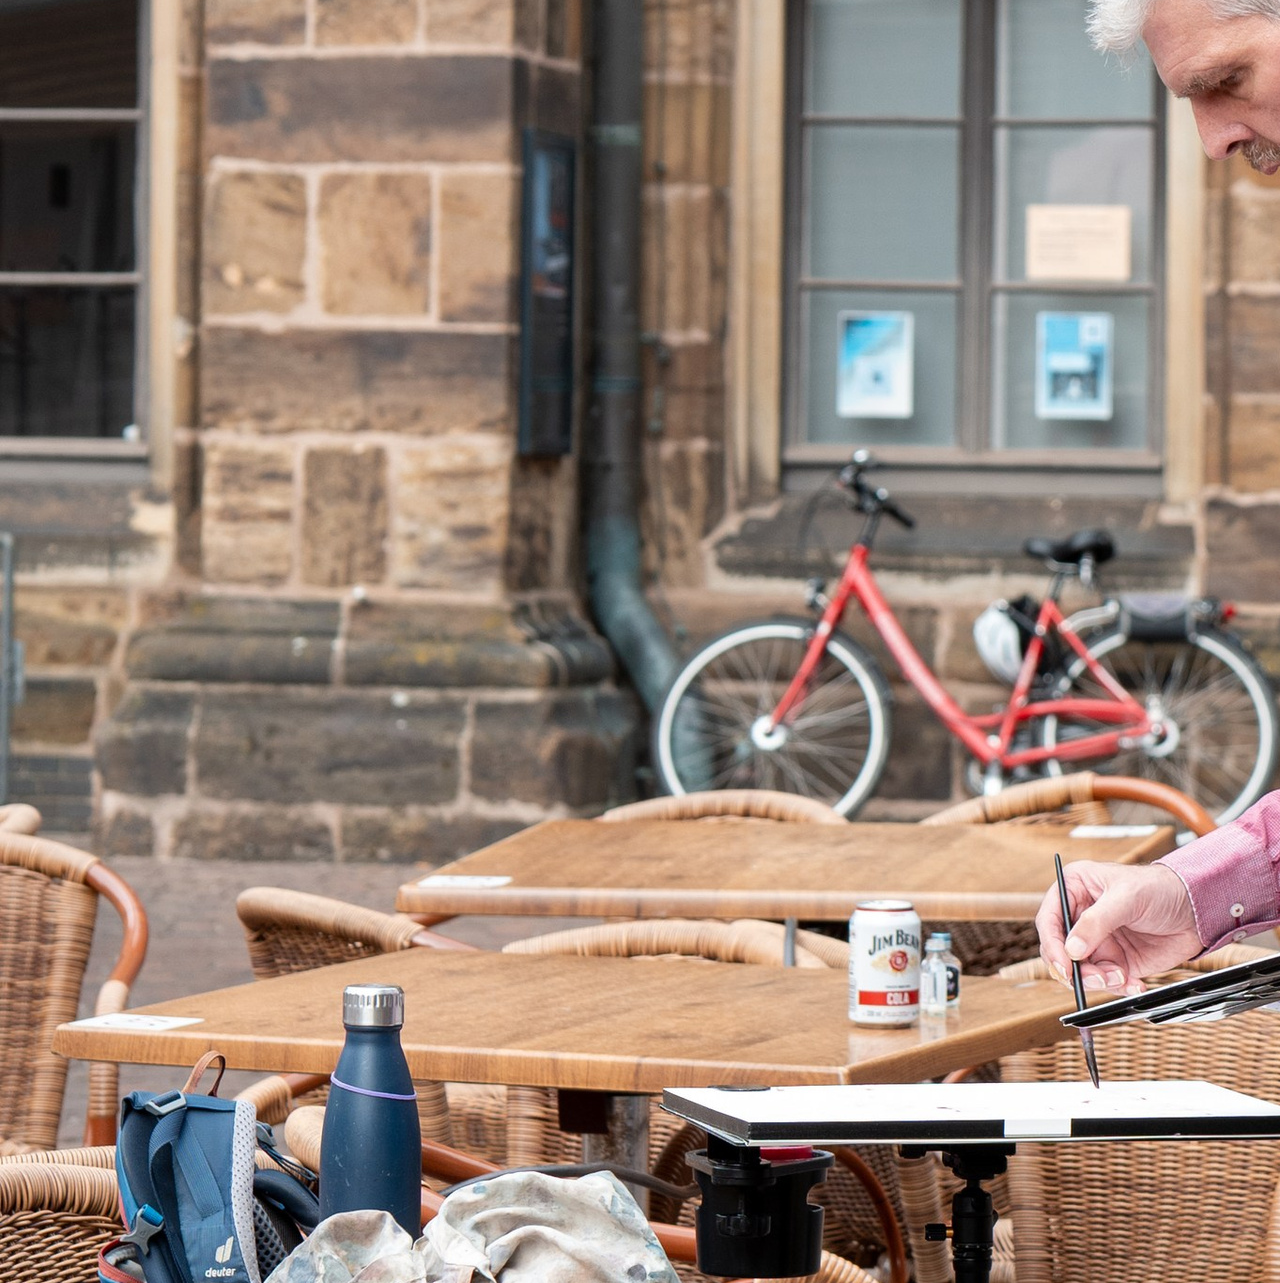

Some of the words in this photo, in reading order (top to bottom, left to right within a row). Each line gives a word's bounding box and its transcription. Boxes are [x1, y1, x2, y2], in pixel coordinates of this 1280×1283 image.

[868, 934, 893, 956] JIM
[886, 992, 910, 1006] COLA
[204, 1267, 237, 1278] deuter
